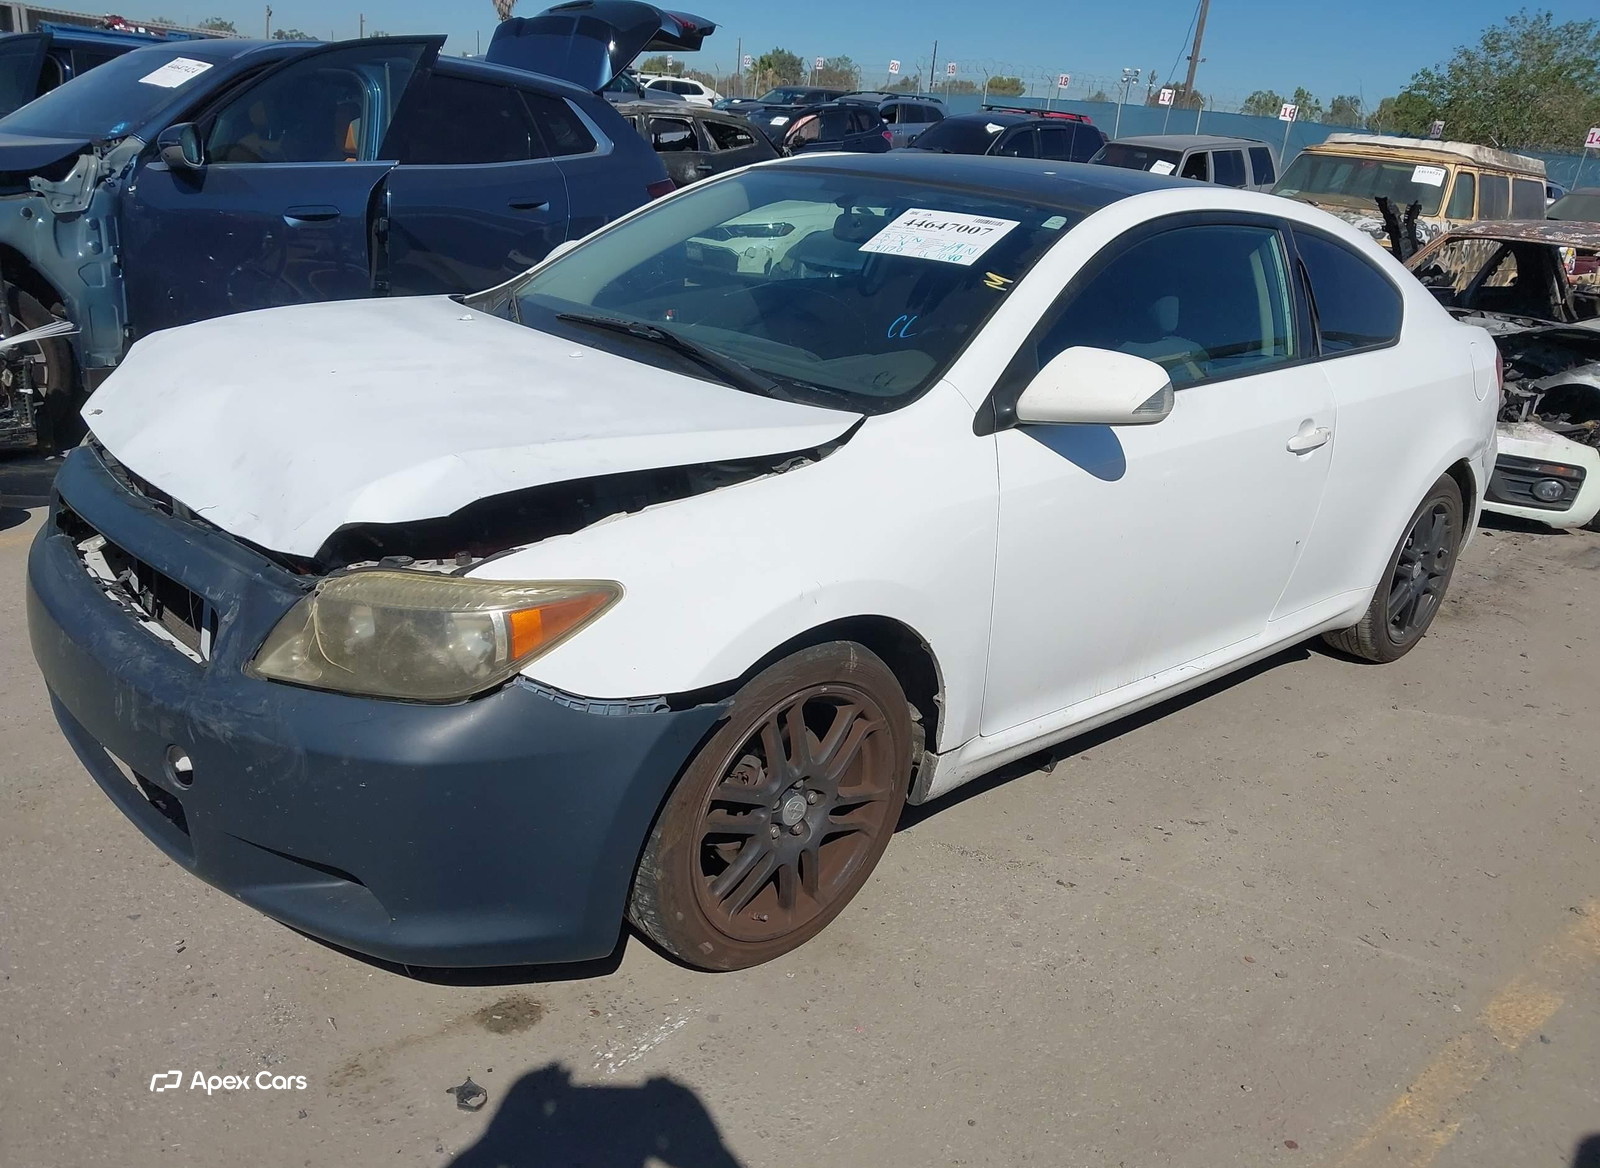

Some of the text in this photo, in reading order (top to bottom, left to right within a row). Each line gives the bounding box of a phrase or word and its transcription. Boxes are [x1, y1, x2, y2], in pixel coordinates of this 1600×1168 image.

[816, 59, 824, 68] 21
[890, 62, 899, 71] 20
[947, 65, 956, 74] 19
[1059, 76, 1068, 86] 18
[1160, 92, 1173, 102] 17
[1281, 107, 1295, 118] 16
[903, 218, 994, 236] 44647007
[887, 314, 918, 339] CL
